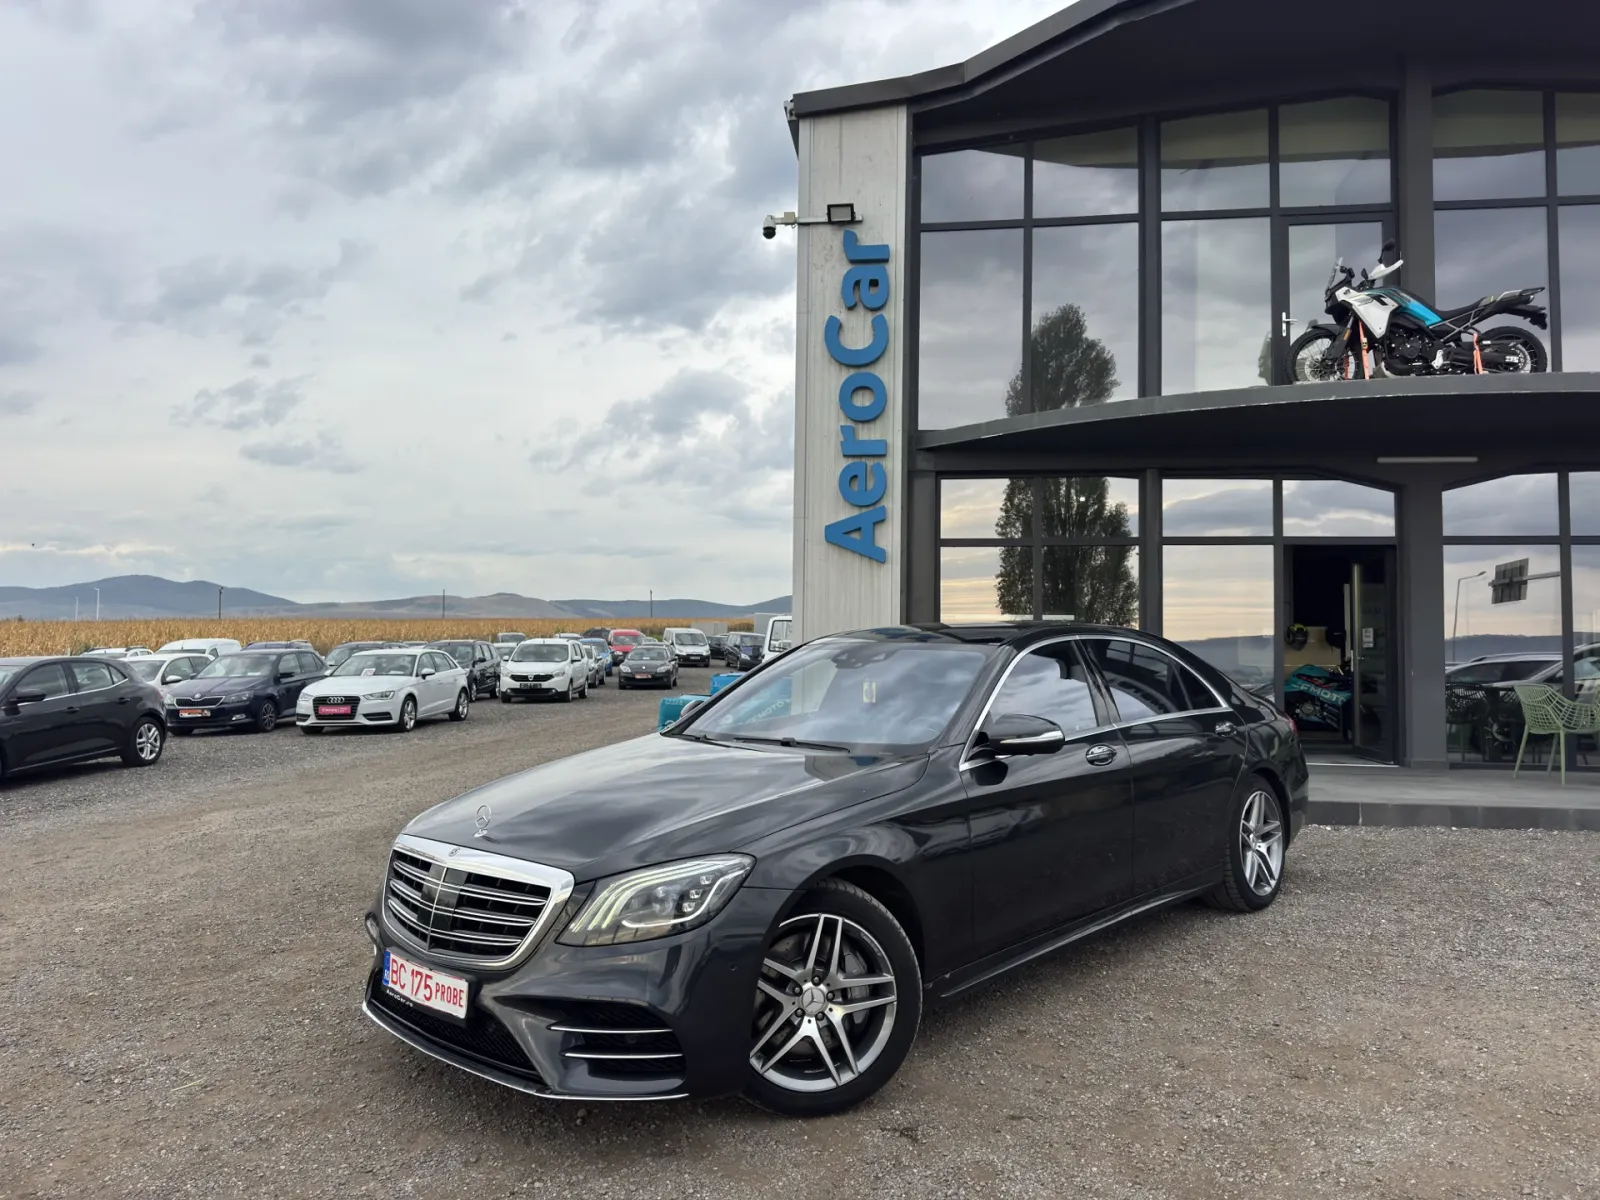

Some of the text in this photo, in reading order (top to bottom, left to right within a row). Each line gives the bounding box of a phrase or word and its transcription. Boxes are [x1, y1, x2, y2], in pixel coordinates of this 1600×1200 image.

[824, 229, 890, 563] AeroCar
[391, 958, 464, 1007] BC 175 PROBE
